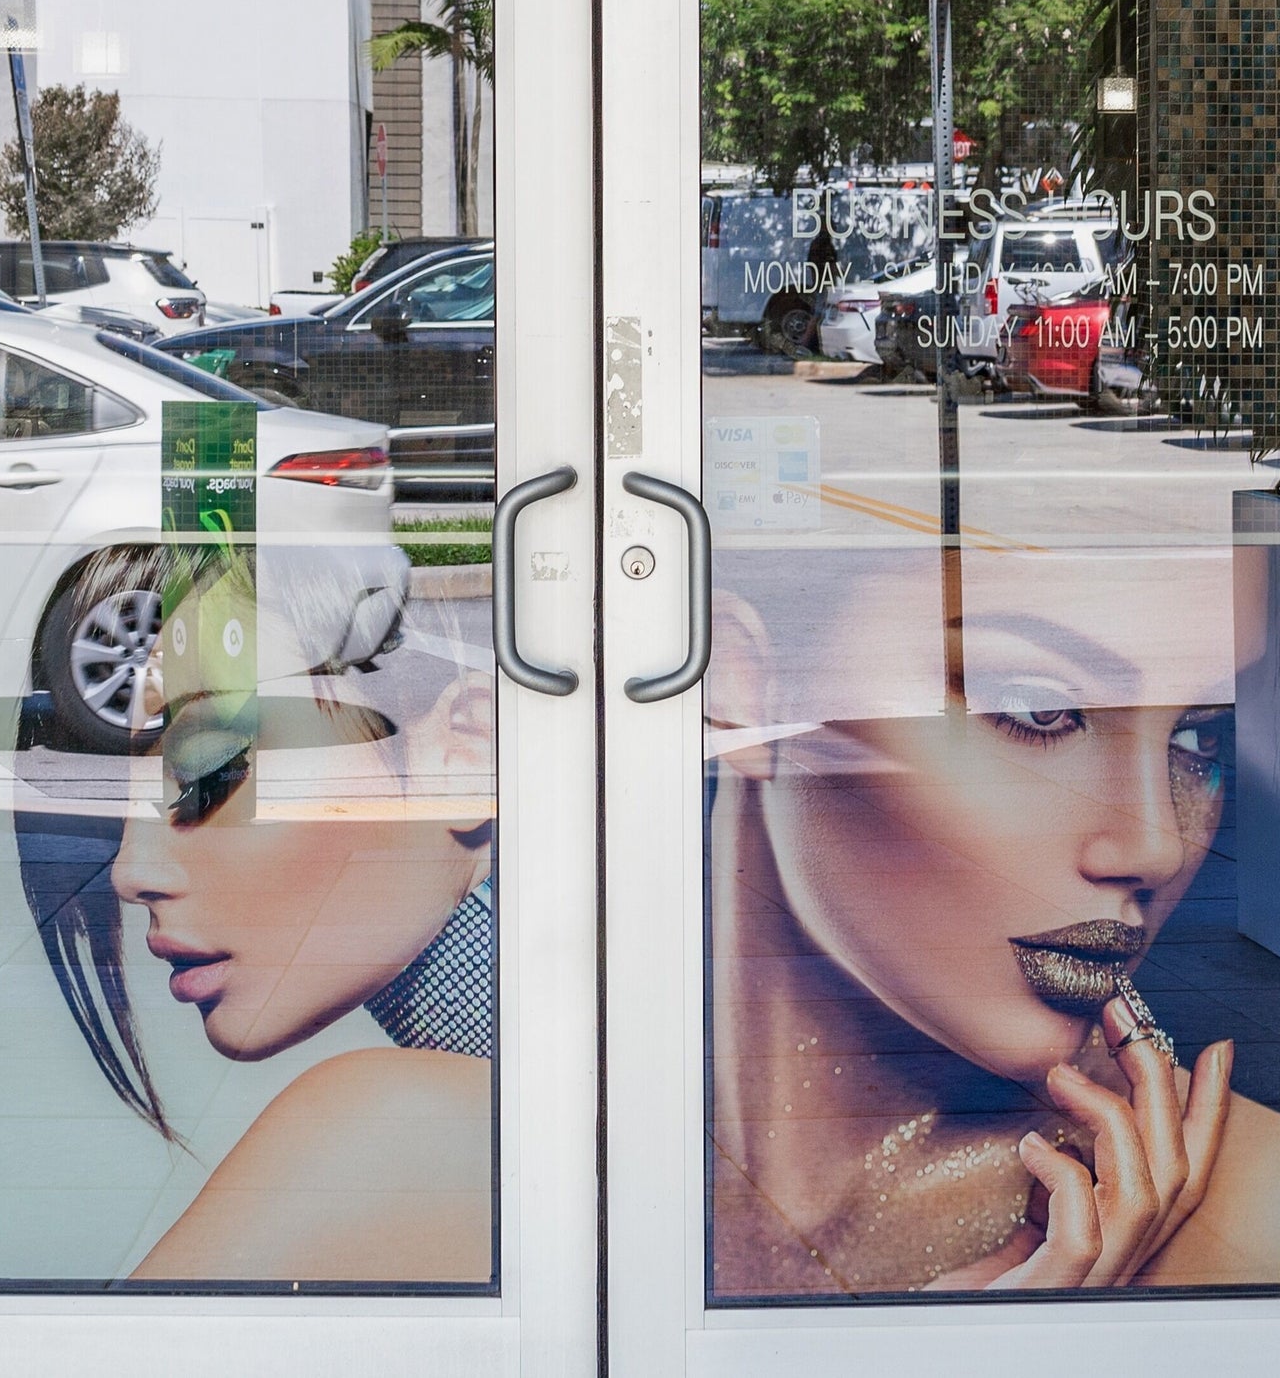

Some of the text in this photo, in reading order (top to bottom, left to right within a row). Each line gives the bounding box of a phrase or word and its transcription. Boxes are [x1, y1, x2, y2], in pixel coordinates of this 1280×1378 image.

[792, 188, 1028, 241] BUSINESS
[744, 261, 852, 294] MONDAY
[1099, 263, 1137, 296] AM
[1168, 263, 1218, 296] 7:00
[1227, 263, 1263, 296] PM
[917, 315, 1017, 348] SUNDAY
[1034, 315, 1090, 348] 11:00
[1098, 316, 1136, 348] AM
[1168, 316, 1218, 349] 5:00
[1226, 316, 1263, 349] PM
[716, 428, 753, 442] VISA
